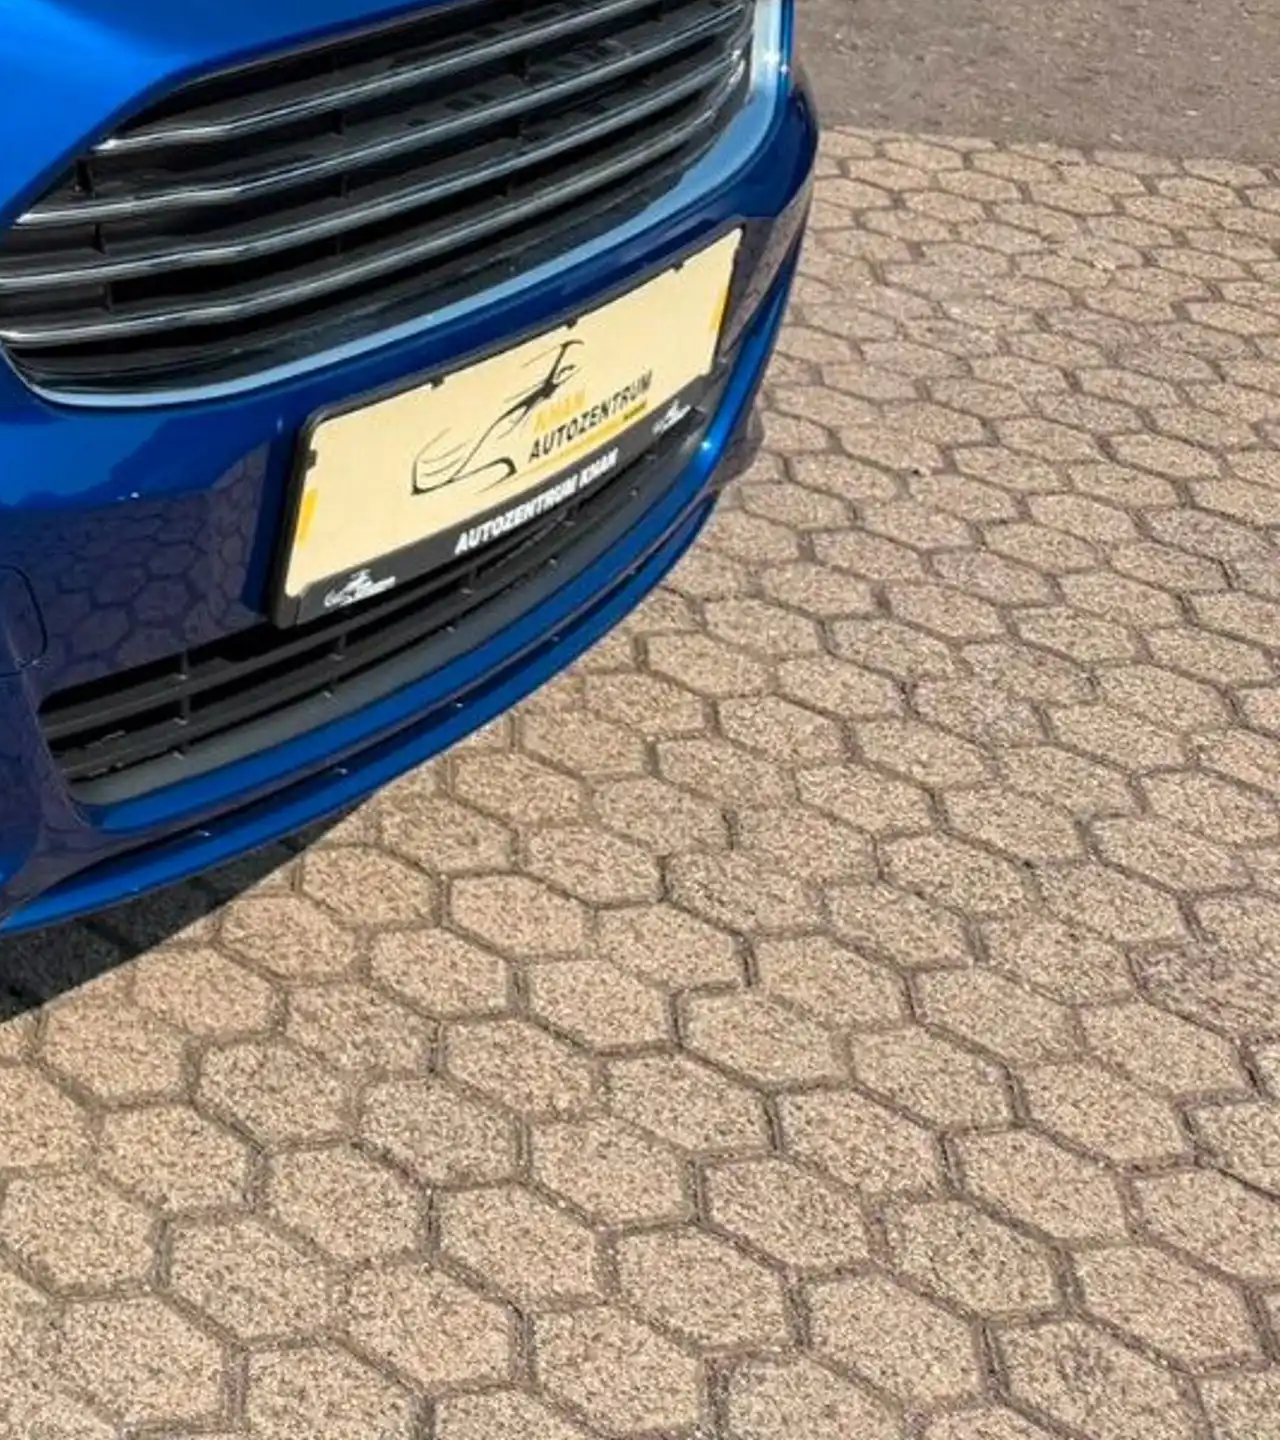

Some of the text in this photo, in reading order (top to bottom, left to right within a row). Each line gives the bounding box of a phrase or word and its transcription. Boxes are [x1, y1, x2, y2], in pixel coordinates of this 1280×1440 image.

[528, 369, 653, 463] AUTOZENTRUM
[454, 447, 619, 555] AUTOZENTRUM KHAN
